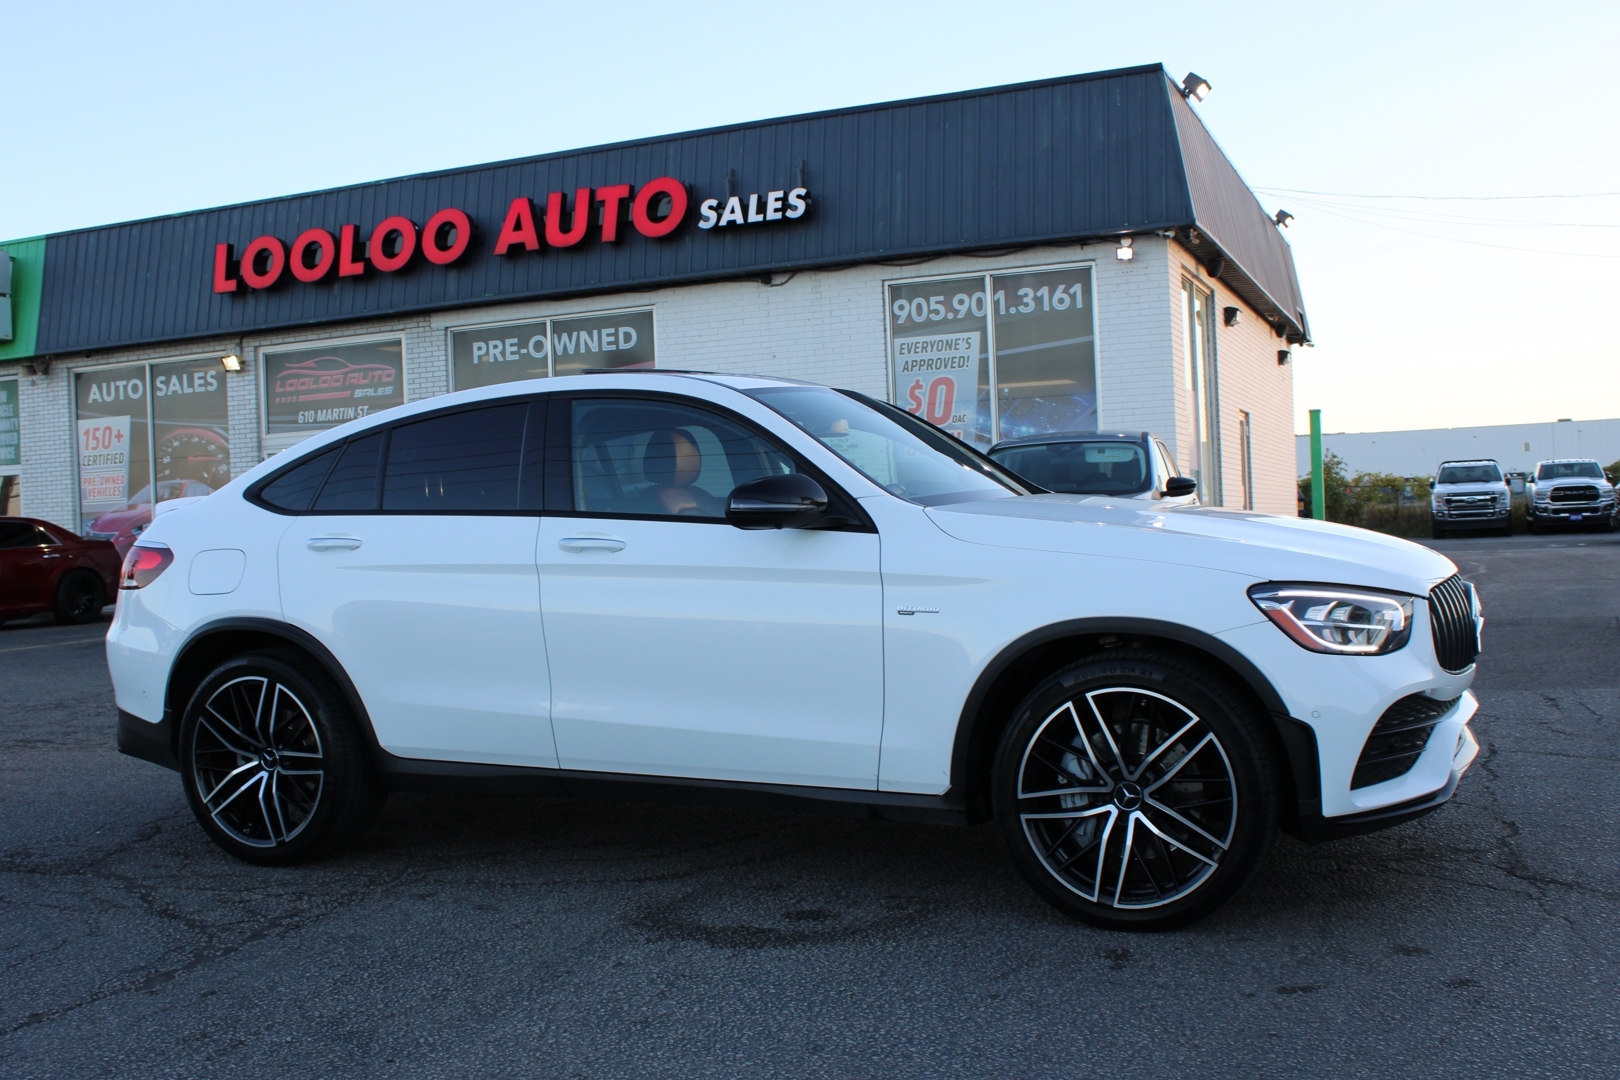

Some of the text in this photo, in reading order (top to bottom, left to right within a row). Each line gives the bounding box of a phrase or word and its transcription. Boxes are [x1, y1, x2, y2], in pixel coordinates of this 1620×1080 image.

[213, 176, 808, 294] LOOLOO AUTO SALES
[893, 283, 1084, 324] 905.901.3161
[473, 326, 638, 365] PRE-OWNED
[898, 337, 973, 356] EVERYONE'S
[901, 355, 971, 374] APPROVED!
[87, 370, 218, 404] AUTO SALES
[275, 369, 396, 393] LOOLOO AUTO
[353, 386, 394, 398] SALES
[908, 376, 956, 427] $0
[298, 410, 315, 424] 610
[317, 406, 355, 422] MARTIN
[952, 414, 967, 423] OAC
[83, 425, 124, 452] 150+
[82, 452, 125, 467] CERTIFIED
[83, 474, 126, 487] PRE-OWNED
[87, 486, 122, 498] VEHICLES
